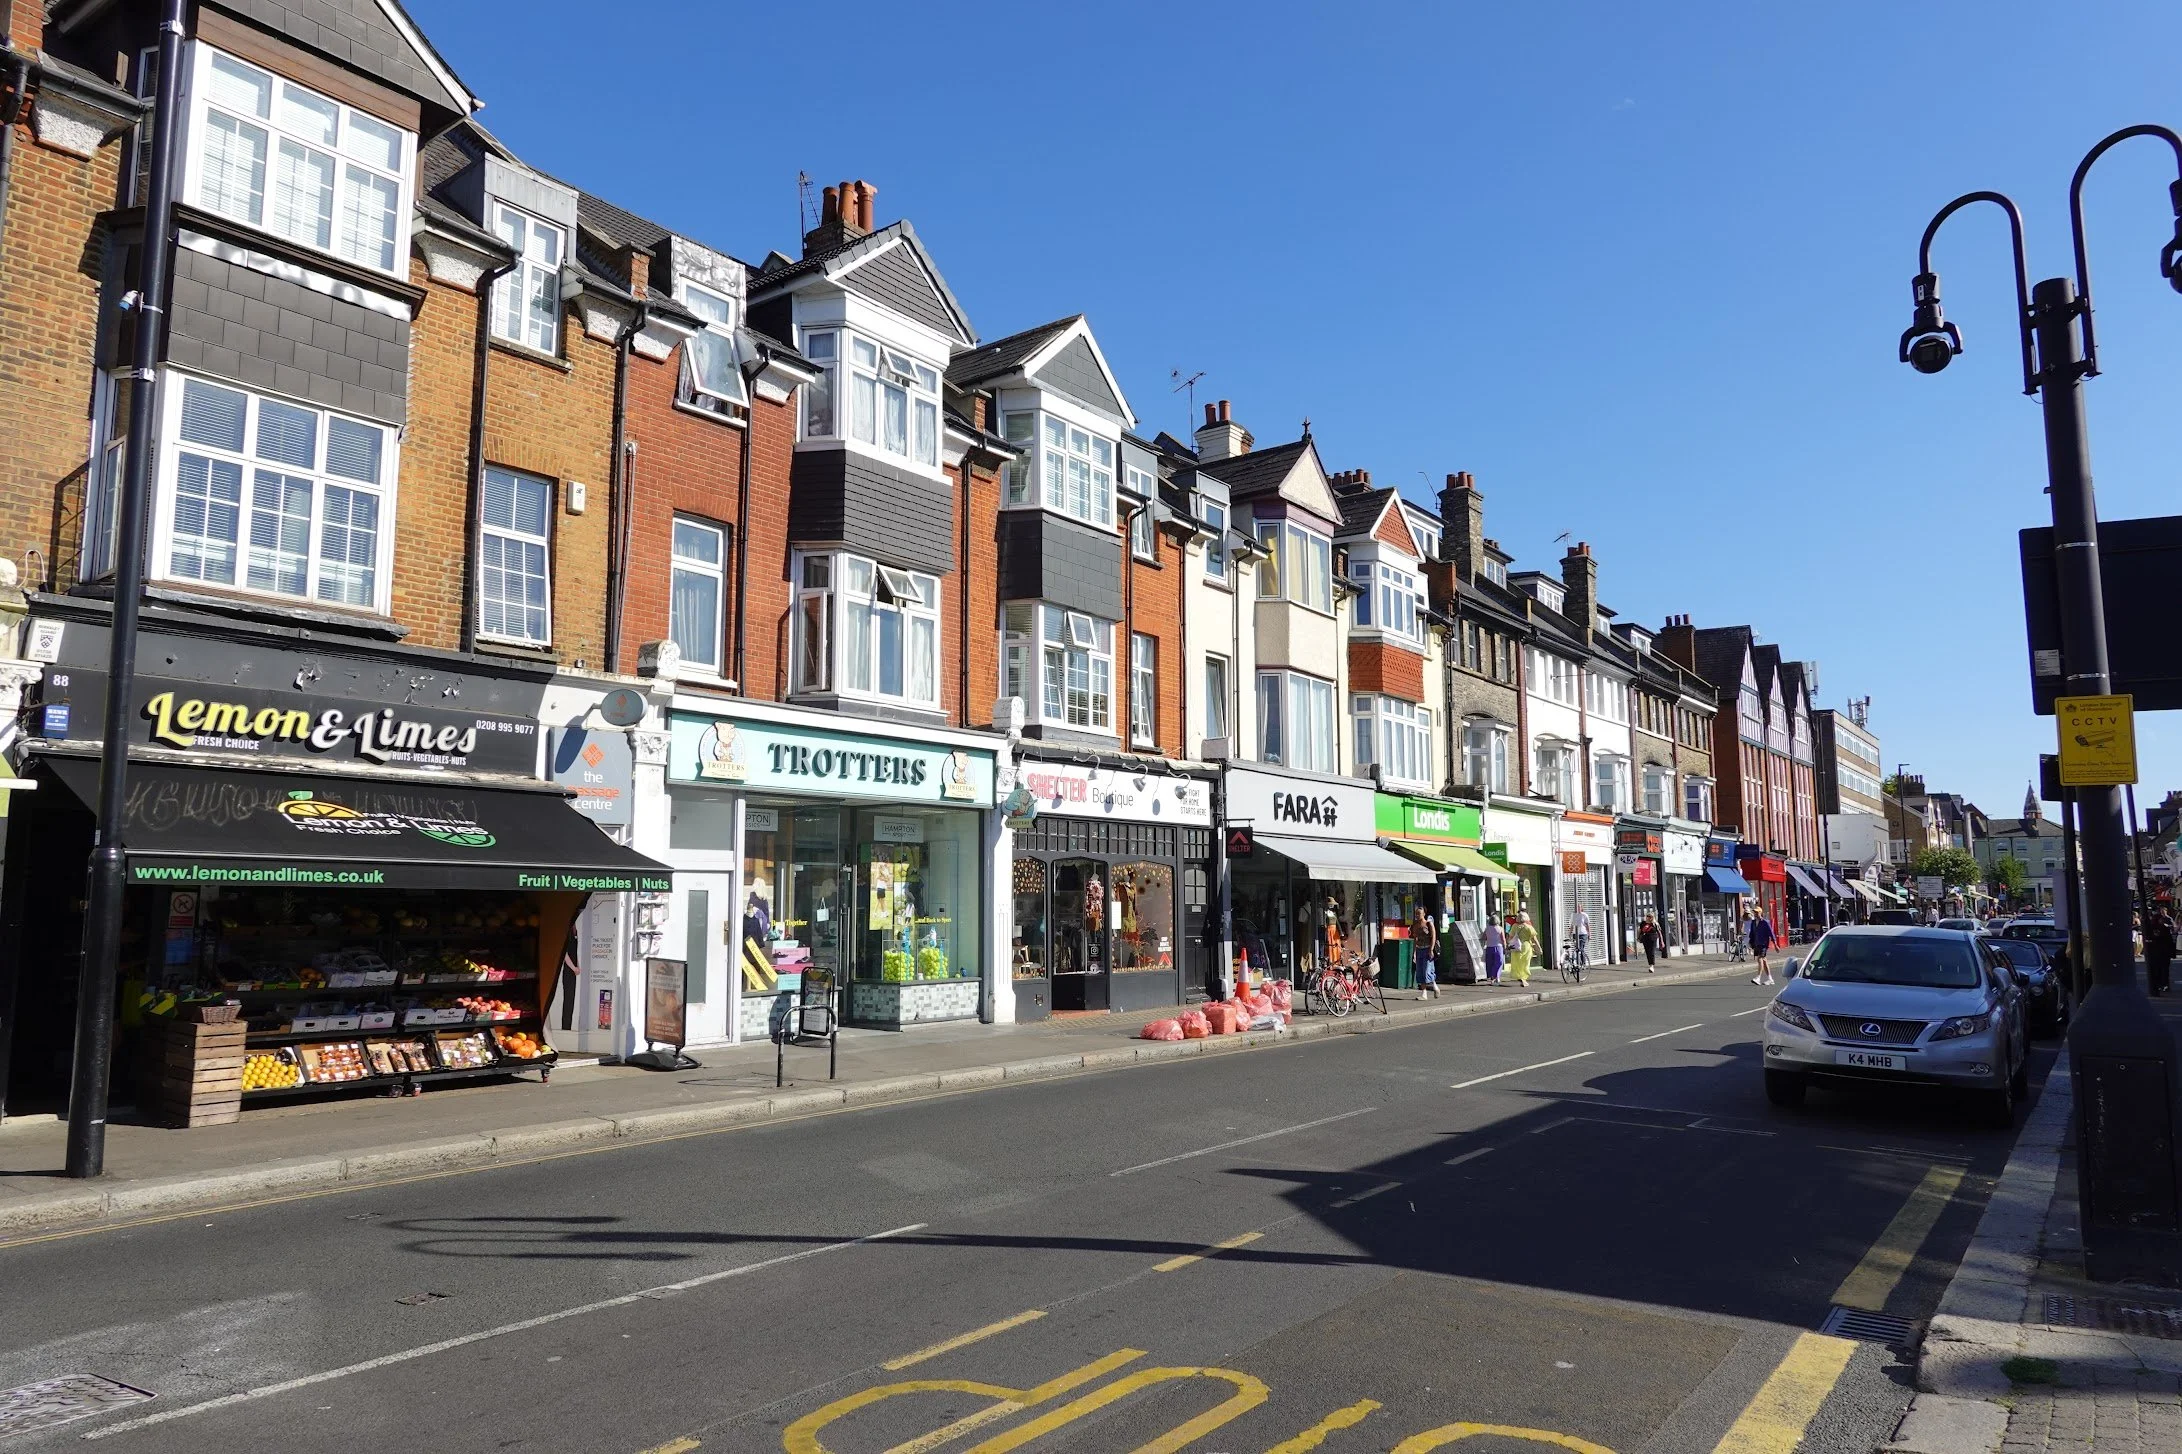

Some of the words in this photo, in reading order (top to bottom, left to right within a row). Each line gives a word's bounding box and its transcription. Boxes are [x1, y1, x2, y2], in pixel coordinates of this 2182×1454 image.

[53, 674, 69, 686] 88
[146, 691, 311, 747] Lemon
[309, 708, 352, 750] &
[352, 708, 478, 762] Limes
[476, 720, 496, 731] 0208
[498, 722, 513, 733] 995
[514, 724, 534, 735] 9077
[193, 735, 222, 748] FRESH
[225, 737, 259, 750] CHOICE
[392, 751, 467, 766] RUITS-VEGETABLES-NUTS
[708, 761, 745, 771] TROTTERS
[768, 742, 927, 786] TROTTERS
[584, 770, 604, 783] the
[1027, 772, 1088, 802] SHELTER
[574, 798, 612, 810] centre
[1092, 787, 1134, 808] Boutique
[1180, 806, 1196, 815] STARTS
[1197, 808, 1207, 816] HERE
[1273, 792, 1322, 825] FARA
[282, 813, 384, 828] Lemon
[386, 816, 411, 829] &
[408, 820, 489, 835] Limes
[746, 814, 769, 823] PTON
[1414, 804, 1450, 831] Londis
[296, 824, 344, 834] Fresh
[1228, 844, 1251, 853] SHELTER
[135, 865, 384, 884] www.lemonandlimes.co.uk
[519, 874, 550, 887] Fruit
[561, 875, 631, 890] Vegetables
[642, 878, 669, 890] Nuts
[1848, 1054, 1864, 1064] K4
[1868, 1056, 1892, 1067] MHB
